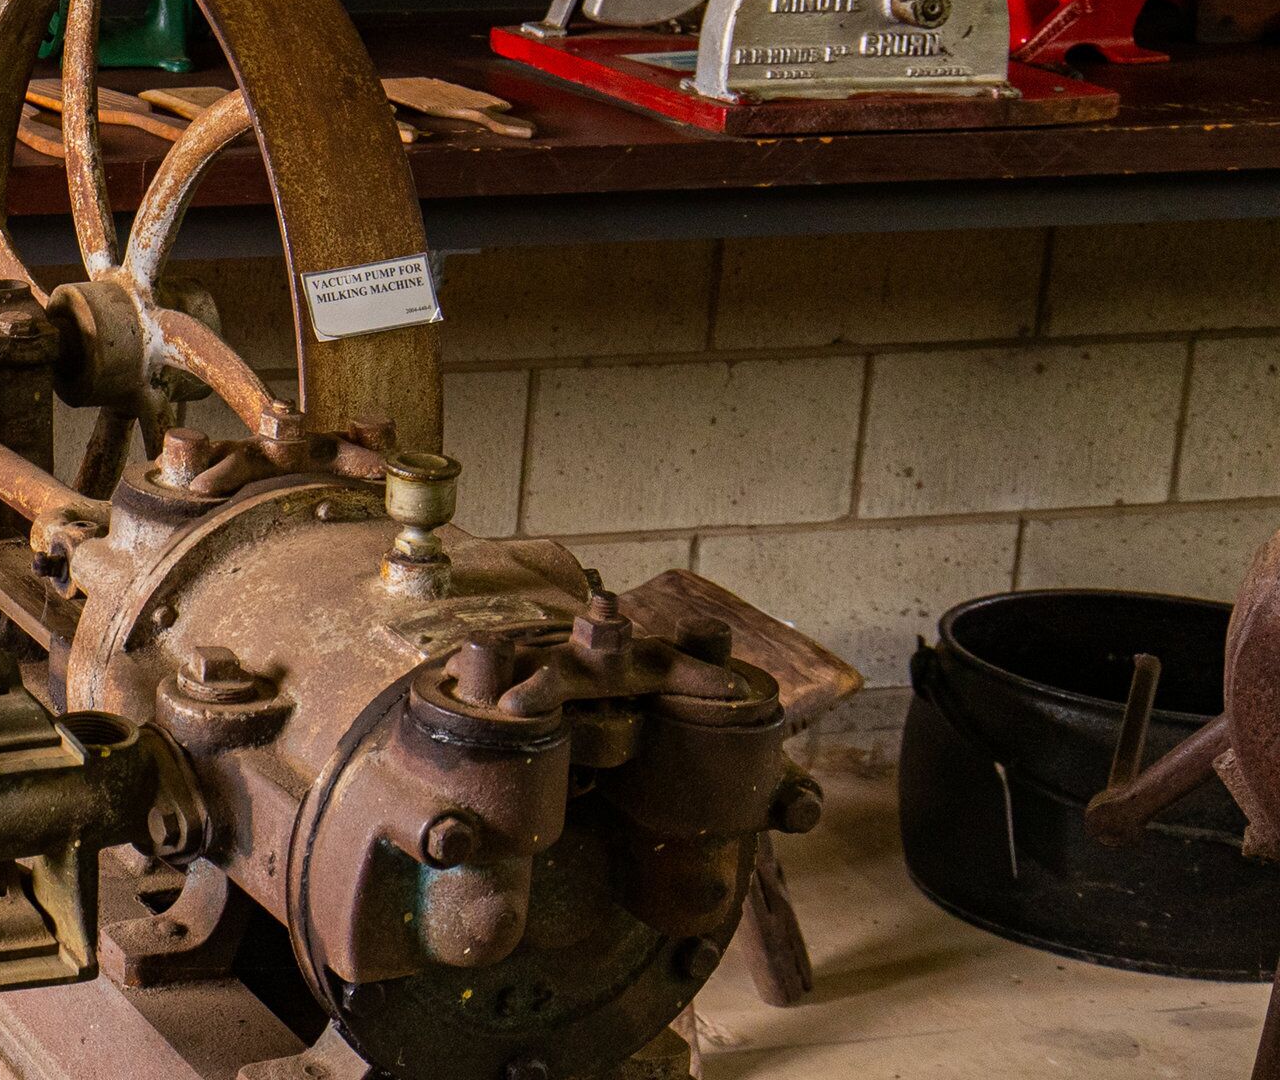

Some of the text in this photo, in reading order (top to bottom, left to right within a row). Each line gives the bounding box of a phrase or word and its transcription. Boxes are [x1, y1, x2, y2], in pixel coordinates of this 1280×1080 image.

[860, 32, 940, 56] CHURN
[312, 263, 423, 290] VACUUM PUMP FOR
[316, 277, 425, 304] MILKING MACHINE
